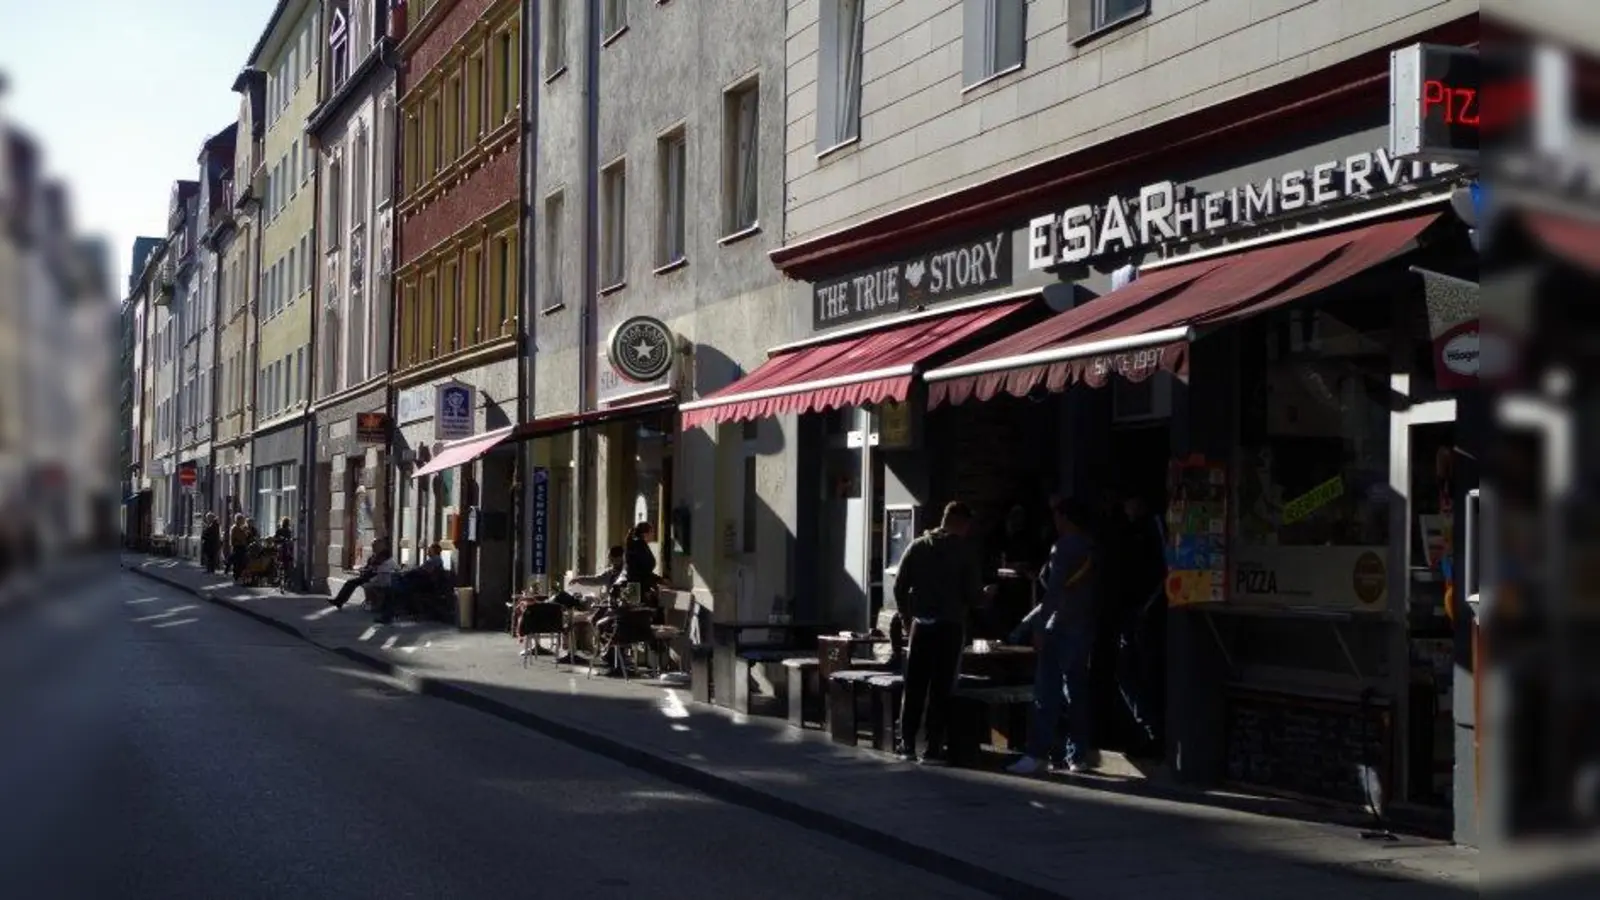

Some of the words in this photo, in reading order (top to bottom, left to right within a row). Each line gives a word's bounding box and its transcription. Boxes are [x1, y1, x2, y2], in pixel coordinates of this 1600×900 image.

[817, 281, 849, 321] THE
[852, 266, 901, 312] TRUE
[929, 232, 1005, 293] STORY
[1133, 347, 1166, 370] 1997
[1236, 569, 1278, 595] PIZZA
